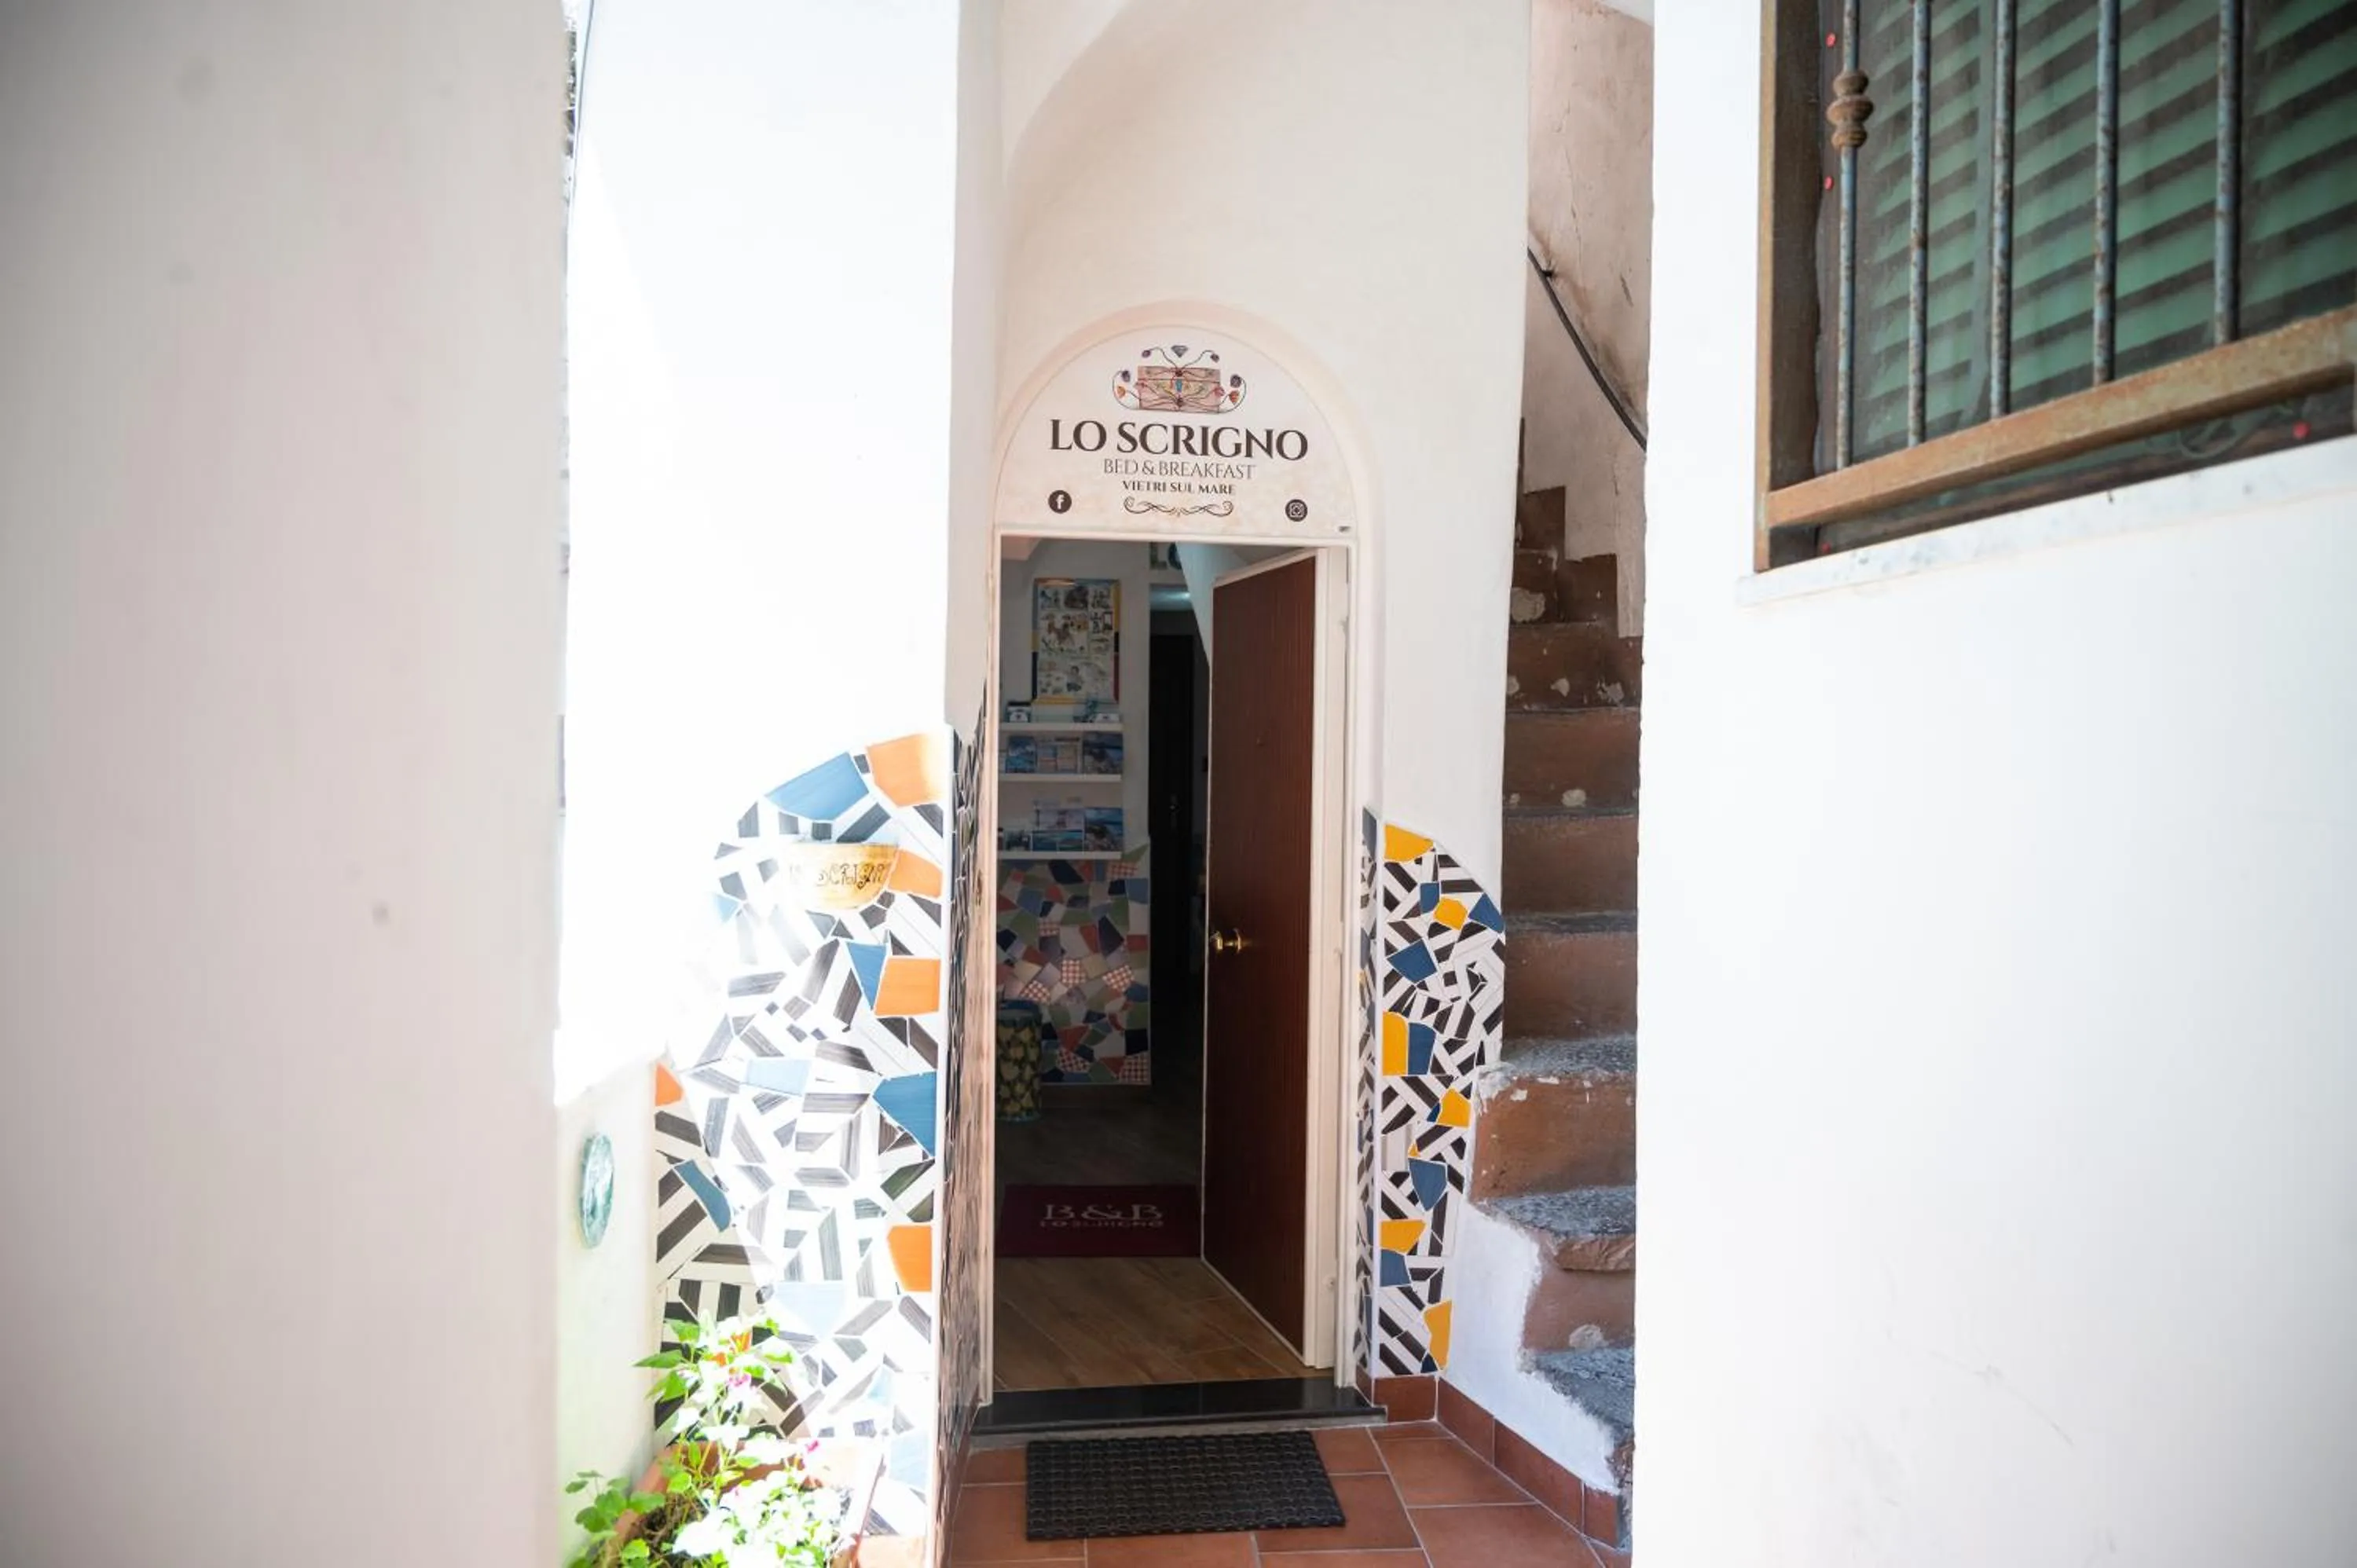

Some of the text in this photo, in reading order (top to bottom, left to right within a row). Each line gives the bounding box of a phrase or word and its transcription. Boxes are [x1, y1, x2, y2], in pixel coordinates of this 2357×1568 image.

[1050, 419, 1308, 461] LO SCRIGNO
[1104, 458, 1257, 480] BED & BREAKFAST
[1123, 480, 1237, 495] VIETRI SUL MARE
[1043, 1203, 1163, 1221] B&B
